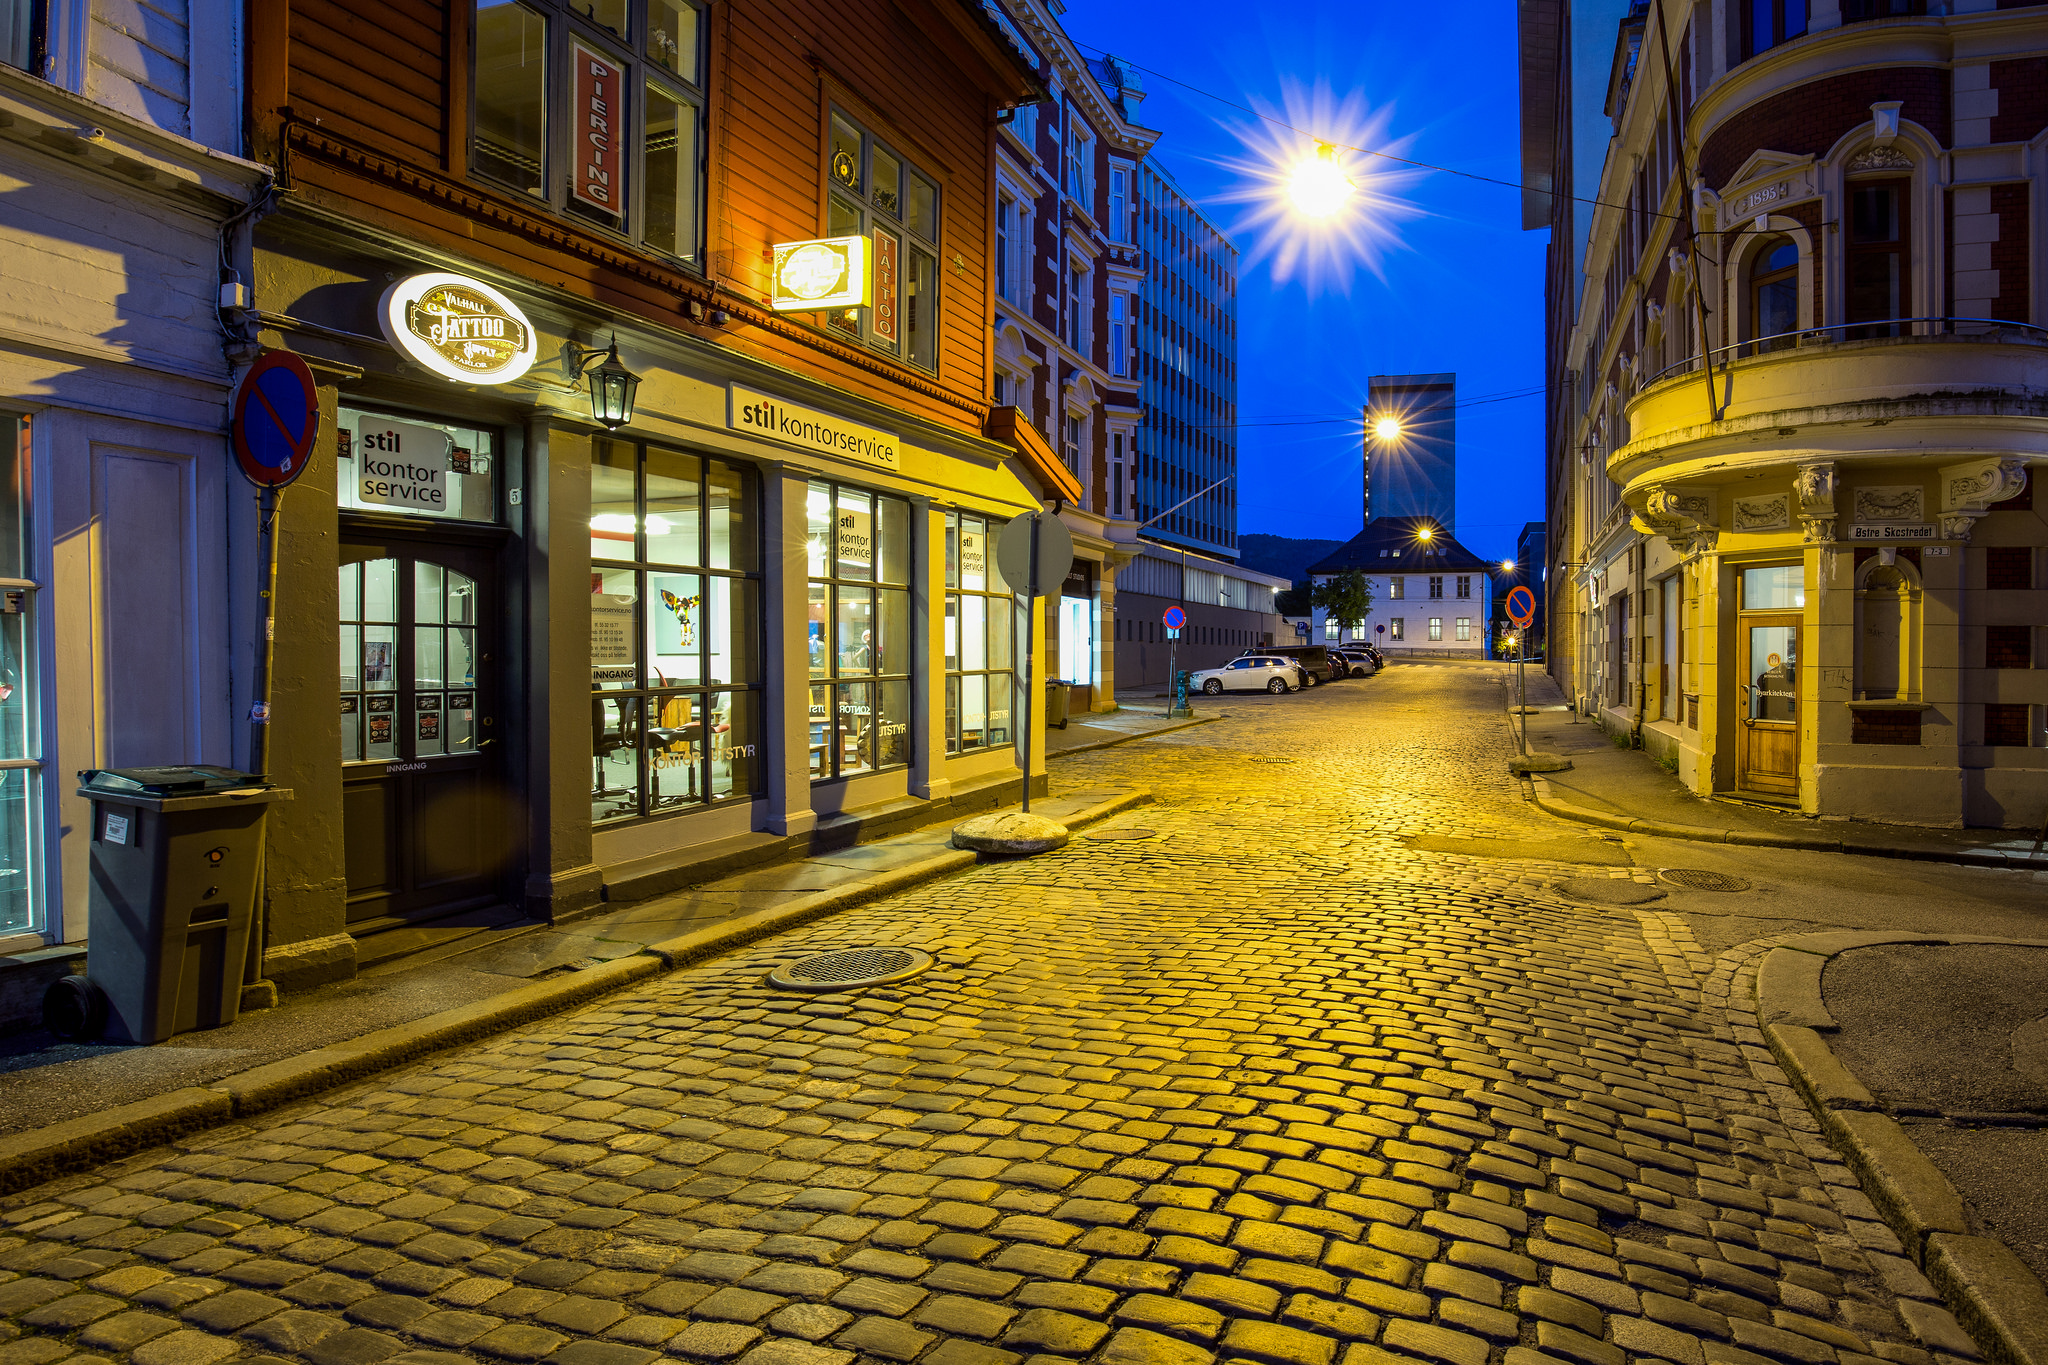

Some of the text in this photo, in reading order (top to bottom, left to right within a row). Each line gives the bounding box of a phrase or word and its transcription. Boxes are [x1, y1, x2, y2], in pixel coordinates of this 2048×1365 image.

[587, 59, 611, 204] PIERCING
[1750, 186, 1777, 207] 1895
[879, 237, 892, 335] TATTOO
[443, 290, 487, 314] VALHALL
[427, 302, 505, 346] TATTOO
[452, 354, 488, 368] PARLOR
[743, 400, 894, 462] stil kontorservice
[363, 430, 401, 453] stil
[363, 453, 438, 483] kontor
[364, 479, 442, 503] service
[511, 490, 519, 503] 5
[840, 514, 855, 529] stil
[840, 530, 869, 547] kontor
[1855, 527, 1932, 537] Østre Skostredet
[962, 536, 973, 547] stil
[840, 544, 871, 559] service
[962, 548, 983, 562] kontor
[962, 560, 984, 572] service
[591, 606, 632, 614] ontorservice.no
[593, 670, 634, 680] INNGANG
[1755, 689, 1793, 698] Byarkitekten
[711, 744, 756, 762] UTSTYR
[386, 762, 427, 773] INNGANG
